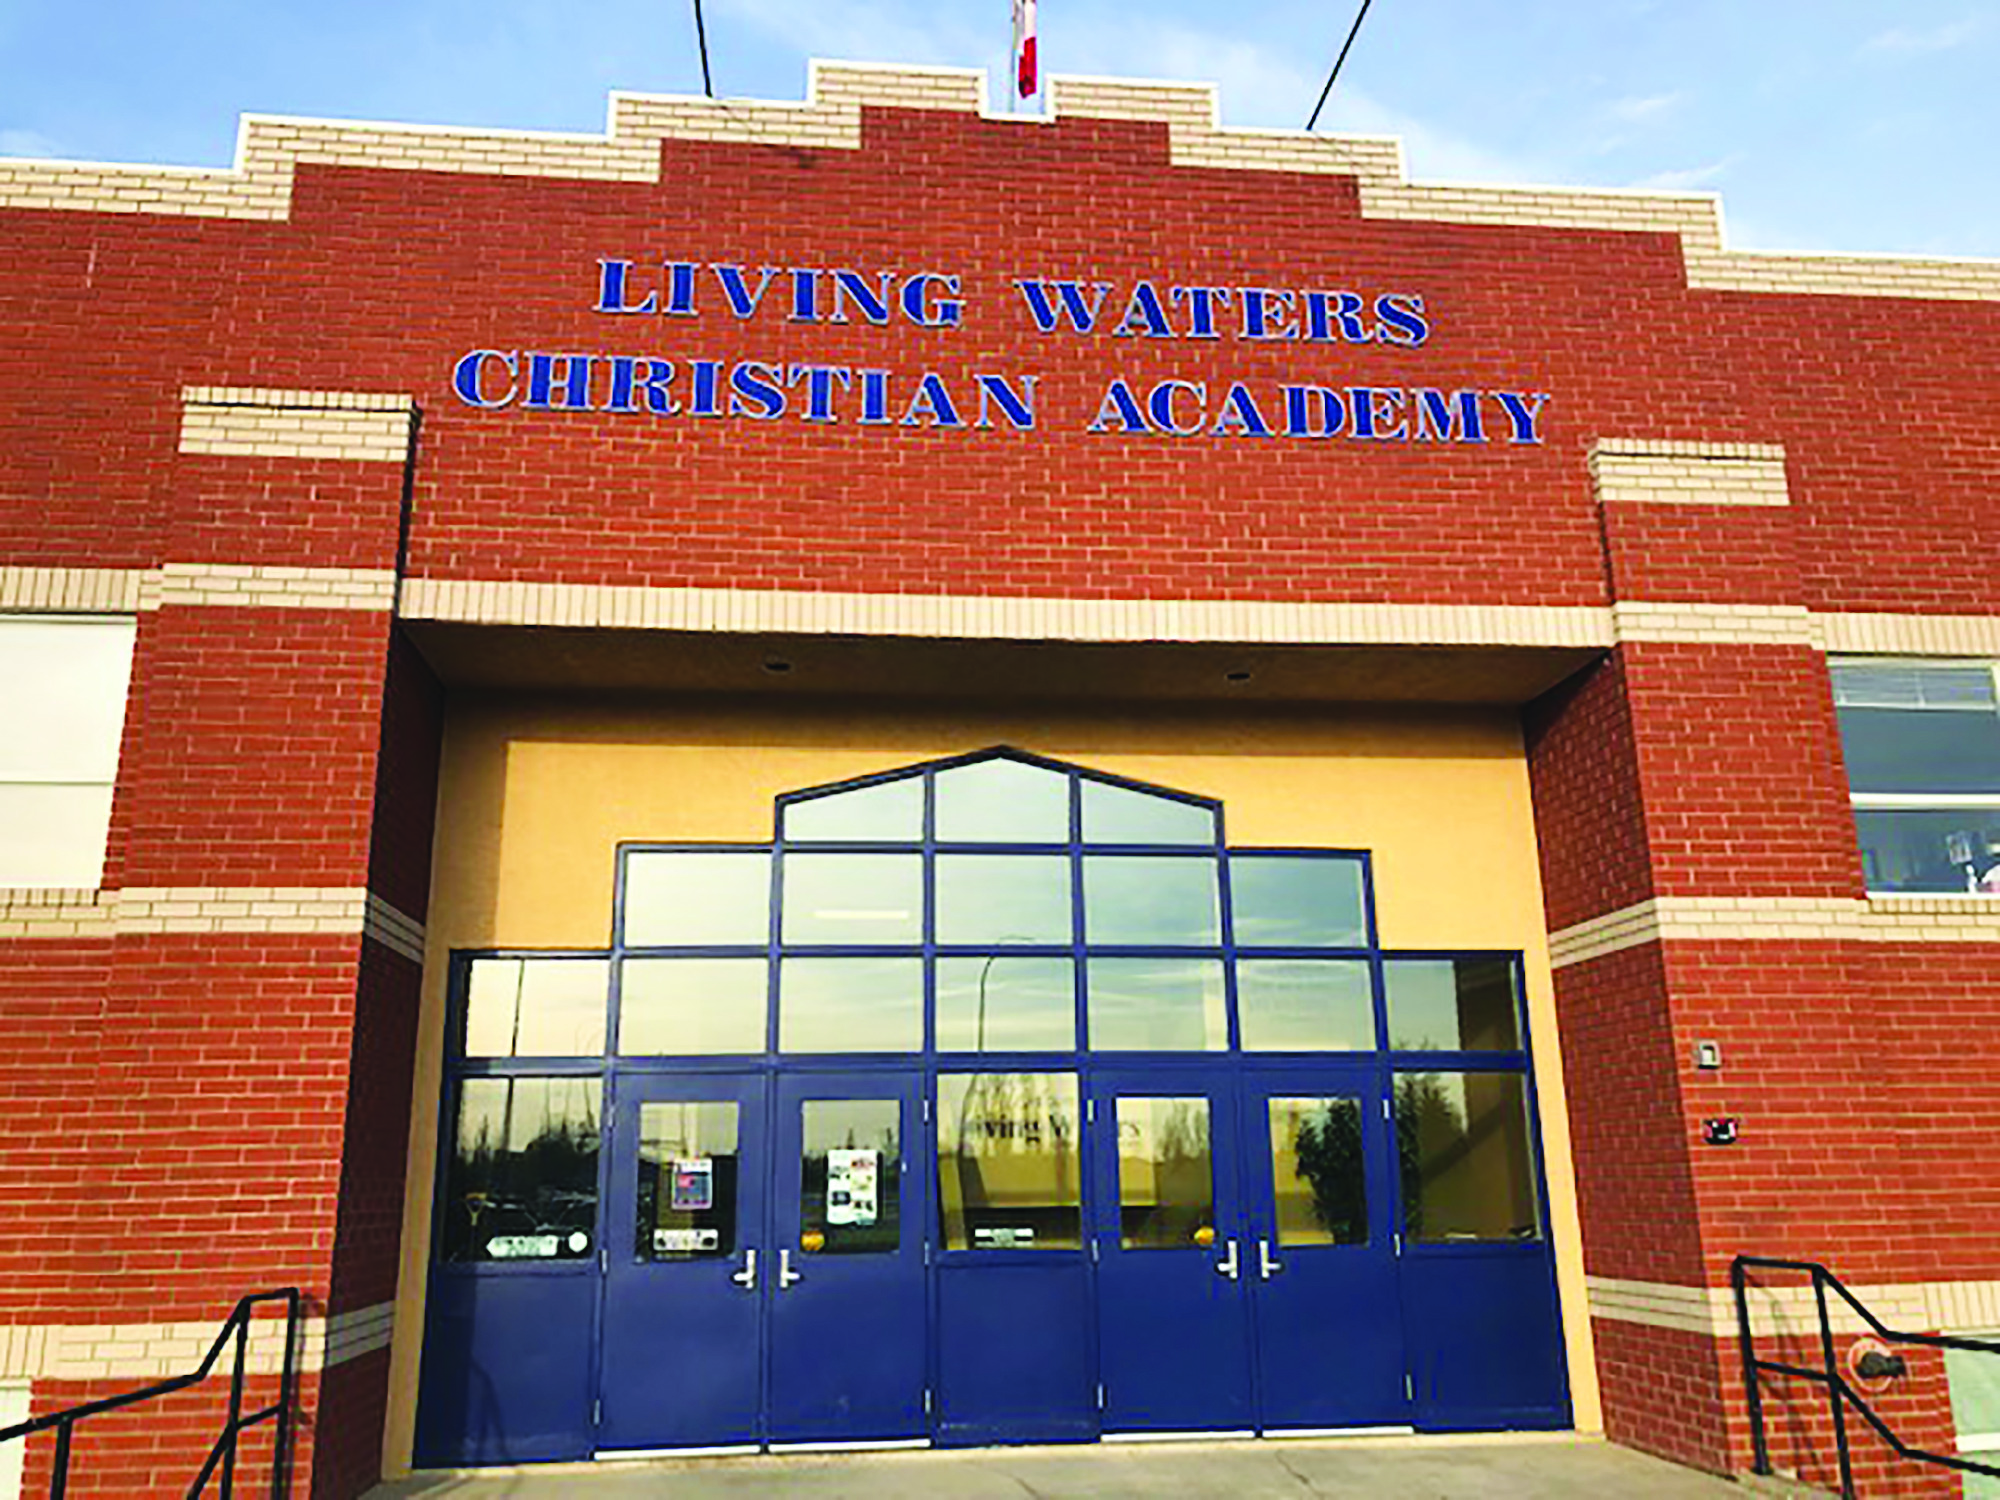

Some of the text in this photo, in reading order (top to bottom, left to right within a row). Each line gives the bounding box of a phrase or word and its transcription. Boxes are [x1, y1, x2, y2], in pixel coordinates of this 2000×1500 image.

[594, 258, 1431, 348] LIVING WATERS
[453, 349, 1550, 445] CHRISTIAN ACADEMY
